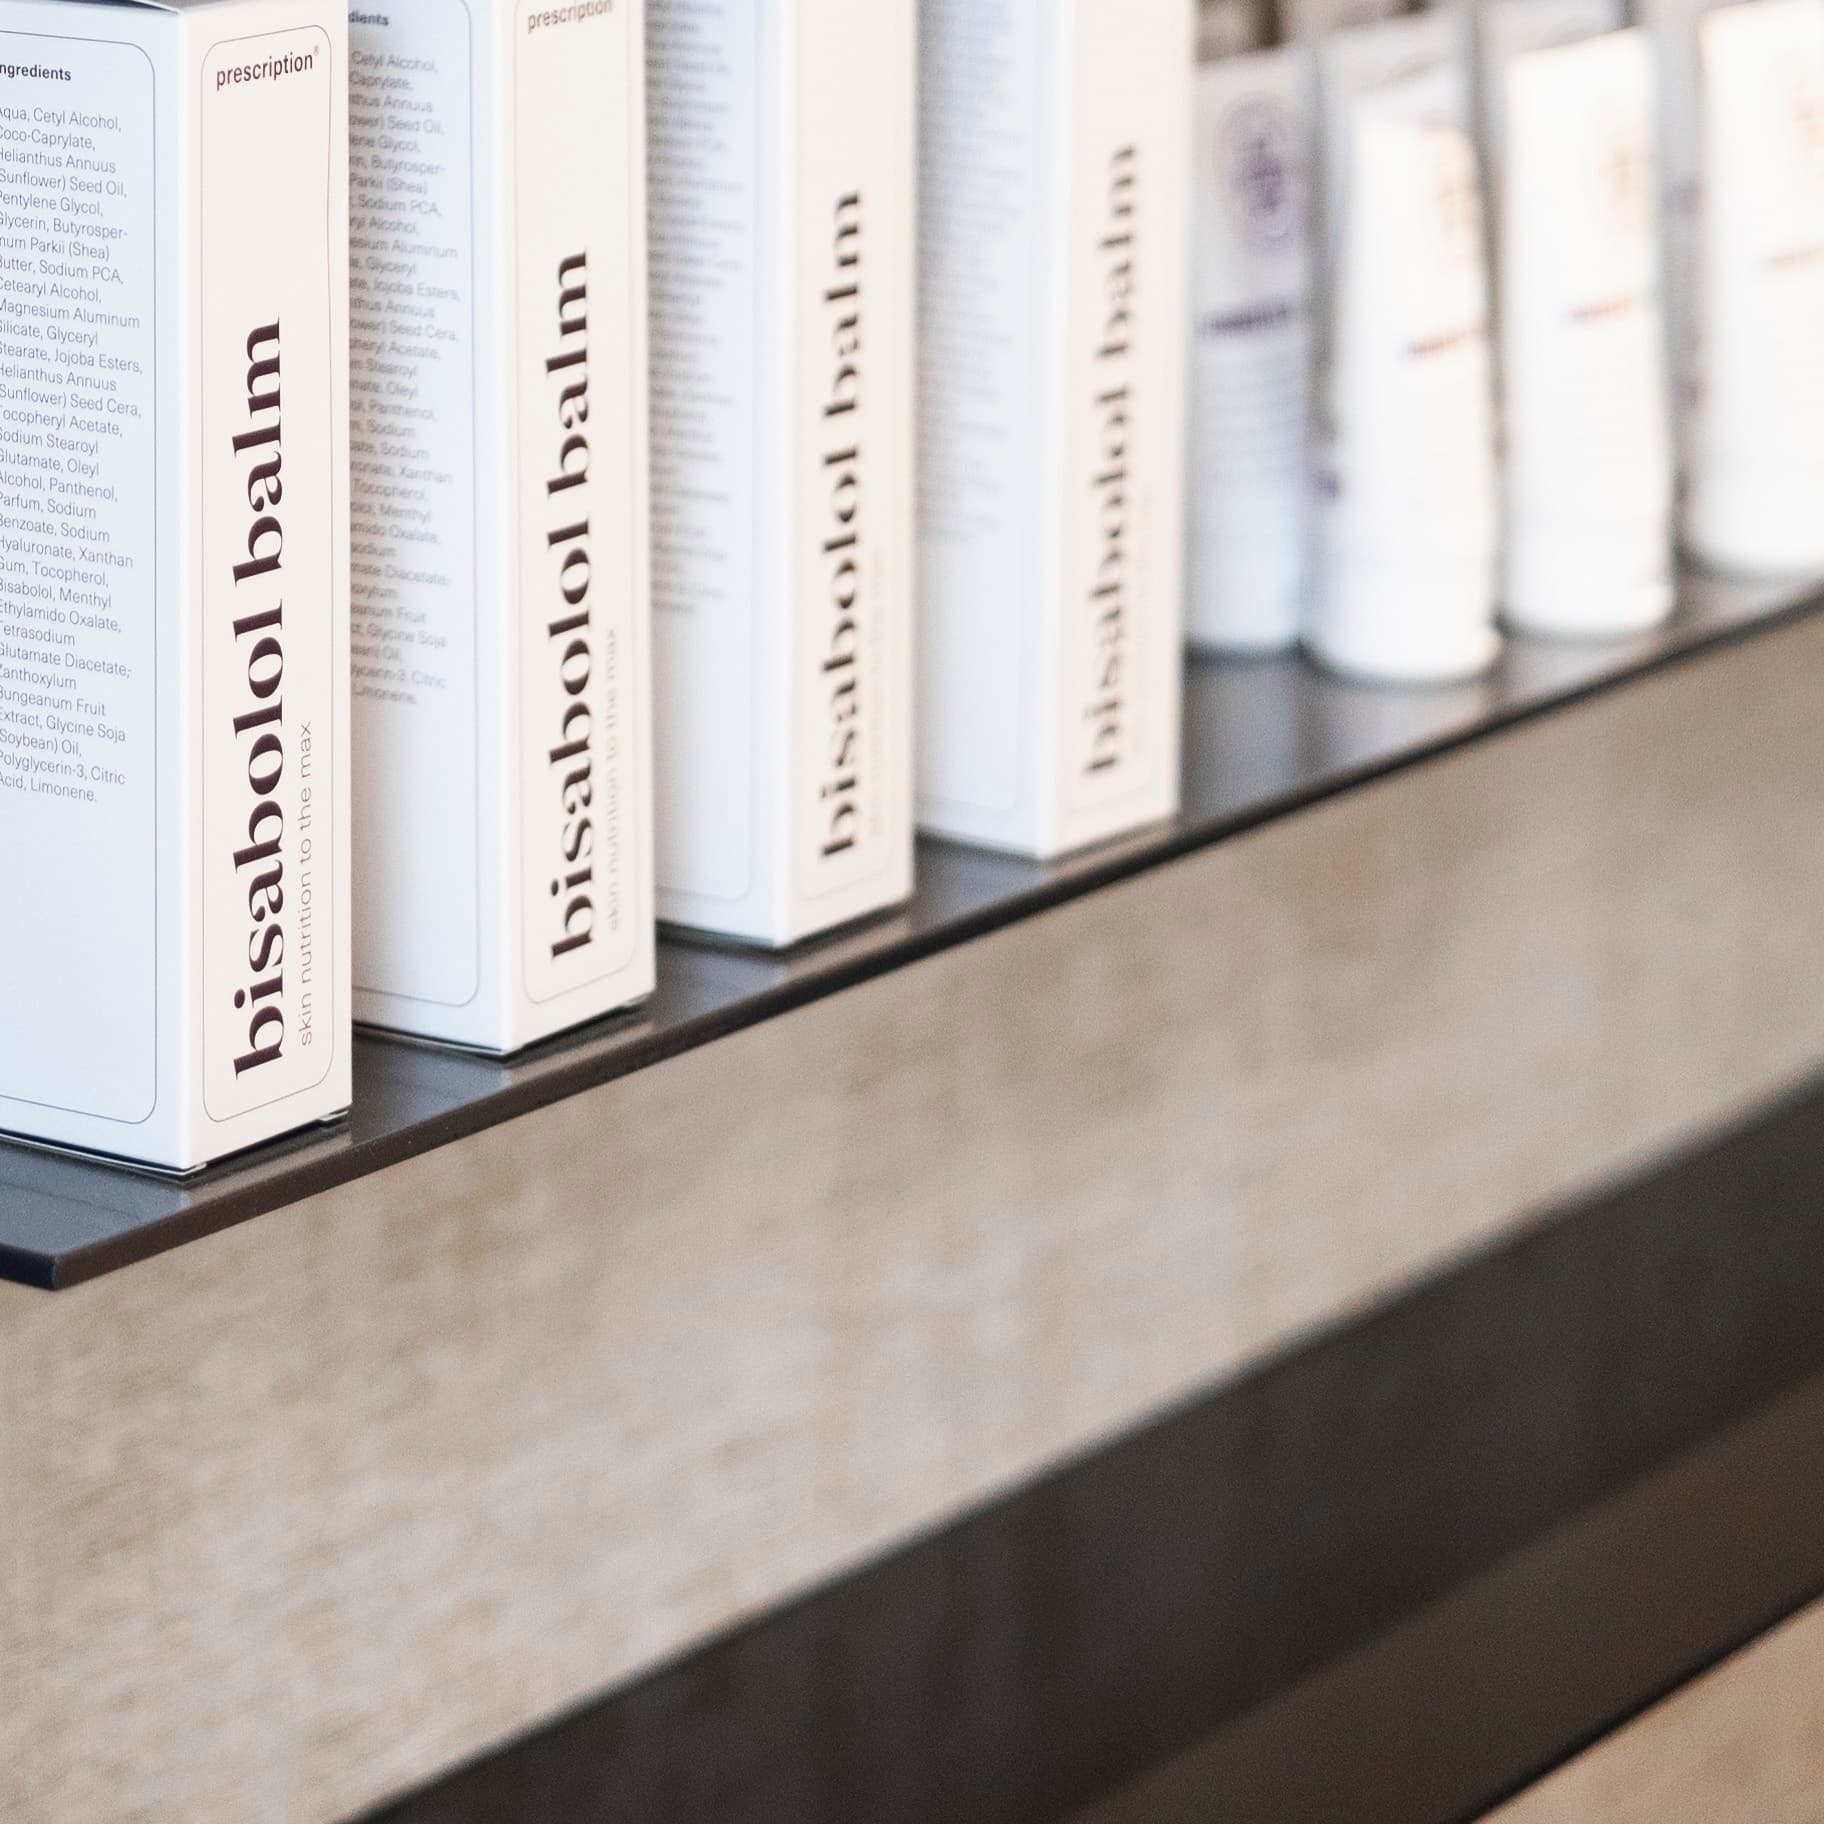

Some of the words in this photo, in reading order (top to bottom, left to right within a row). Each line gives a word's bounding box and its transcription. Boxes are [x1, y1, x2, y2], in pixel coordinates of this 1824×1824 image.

[216, 44, 320, 91] prescription®
[33, 107, 65, 127] Cetyl
[65, 154, 116, 174] Annuus
[70, 176, 102, 194] Seed
[30, 236, 65, 254] Parkii
[68, 241, 110, 262] (Shea)
[39, 259, 88, 279] Sodium
[823, 189, 860, 419] balm
[73, 307, 140, 329] Aluminum
[46, 325, 98, 348] Glyceryl
[54, 347, 95, 367] Jojoba
[66, 371, 117, 392] Annuus
[545, 246, 589, 503] balm
[70, 393, 103, 412] Seed
[46, 433, 98, 457] Stearoyl
[231, 315, 283, 589] balm
[67, 458, 99, 479] Oleyl
[47, 498, 96, 519] Sodium
[60, 522, 110, 543] Sodium
[79, 546, 133, 568] Xanthan
[59, 586, 112, 611] Menthyl
[821, 442, 859, 859] bisabolol
[76, 698, 106, 717] Fruit
[46, 714, 94, 736] Glycine
[97, 723, 126, 744] Soja
[546, 517, 594, 965] bisabolol
[299, 720, 313, 780] max
[297, 785, 313, 833] the
[232, 598, 285, 1080] bisabolol
[298, 837, 313, 866] to
[297, 870, 313, 986] nutrition
[298, 992, 313, 1047] skin
